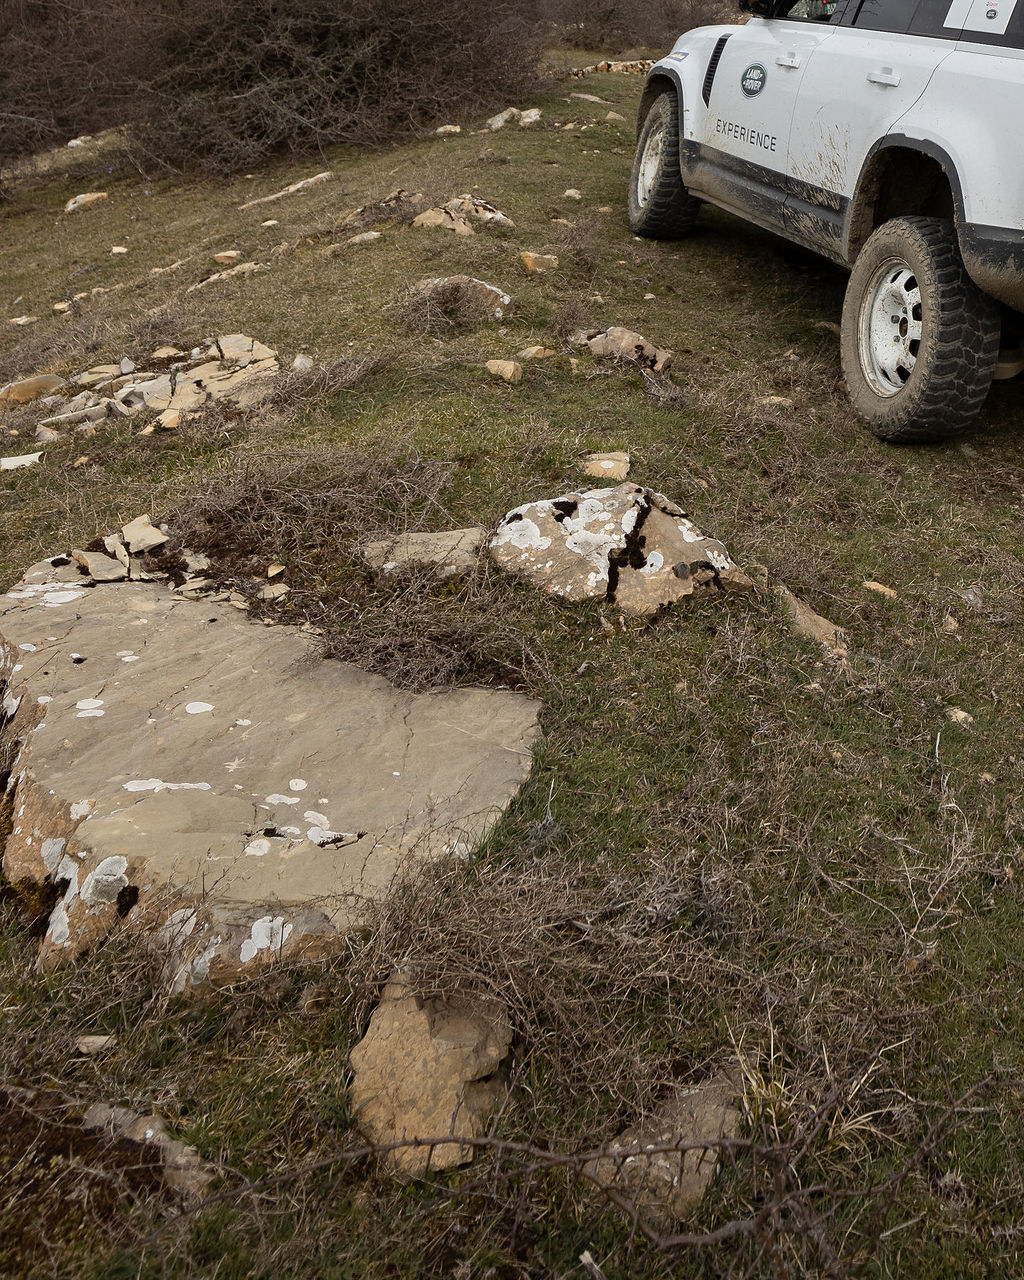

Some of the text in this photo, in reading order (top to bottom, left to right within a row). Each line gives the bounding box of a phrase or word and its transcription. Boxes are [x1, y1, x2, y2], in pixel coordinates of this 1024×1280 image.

[746, 68, 761, 80] LAND
[744, 79, 762, 91] ROVER
[716, 119, 777, 152] EXPERIENCE
